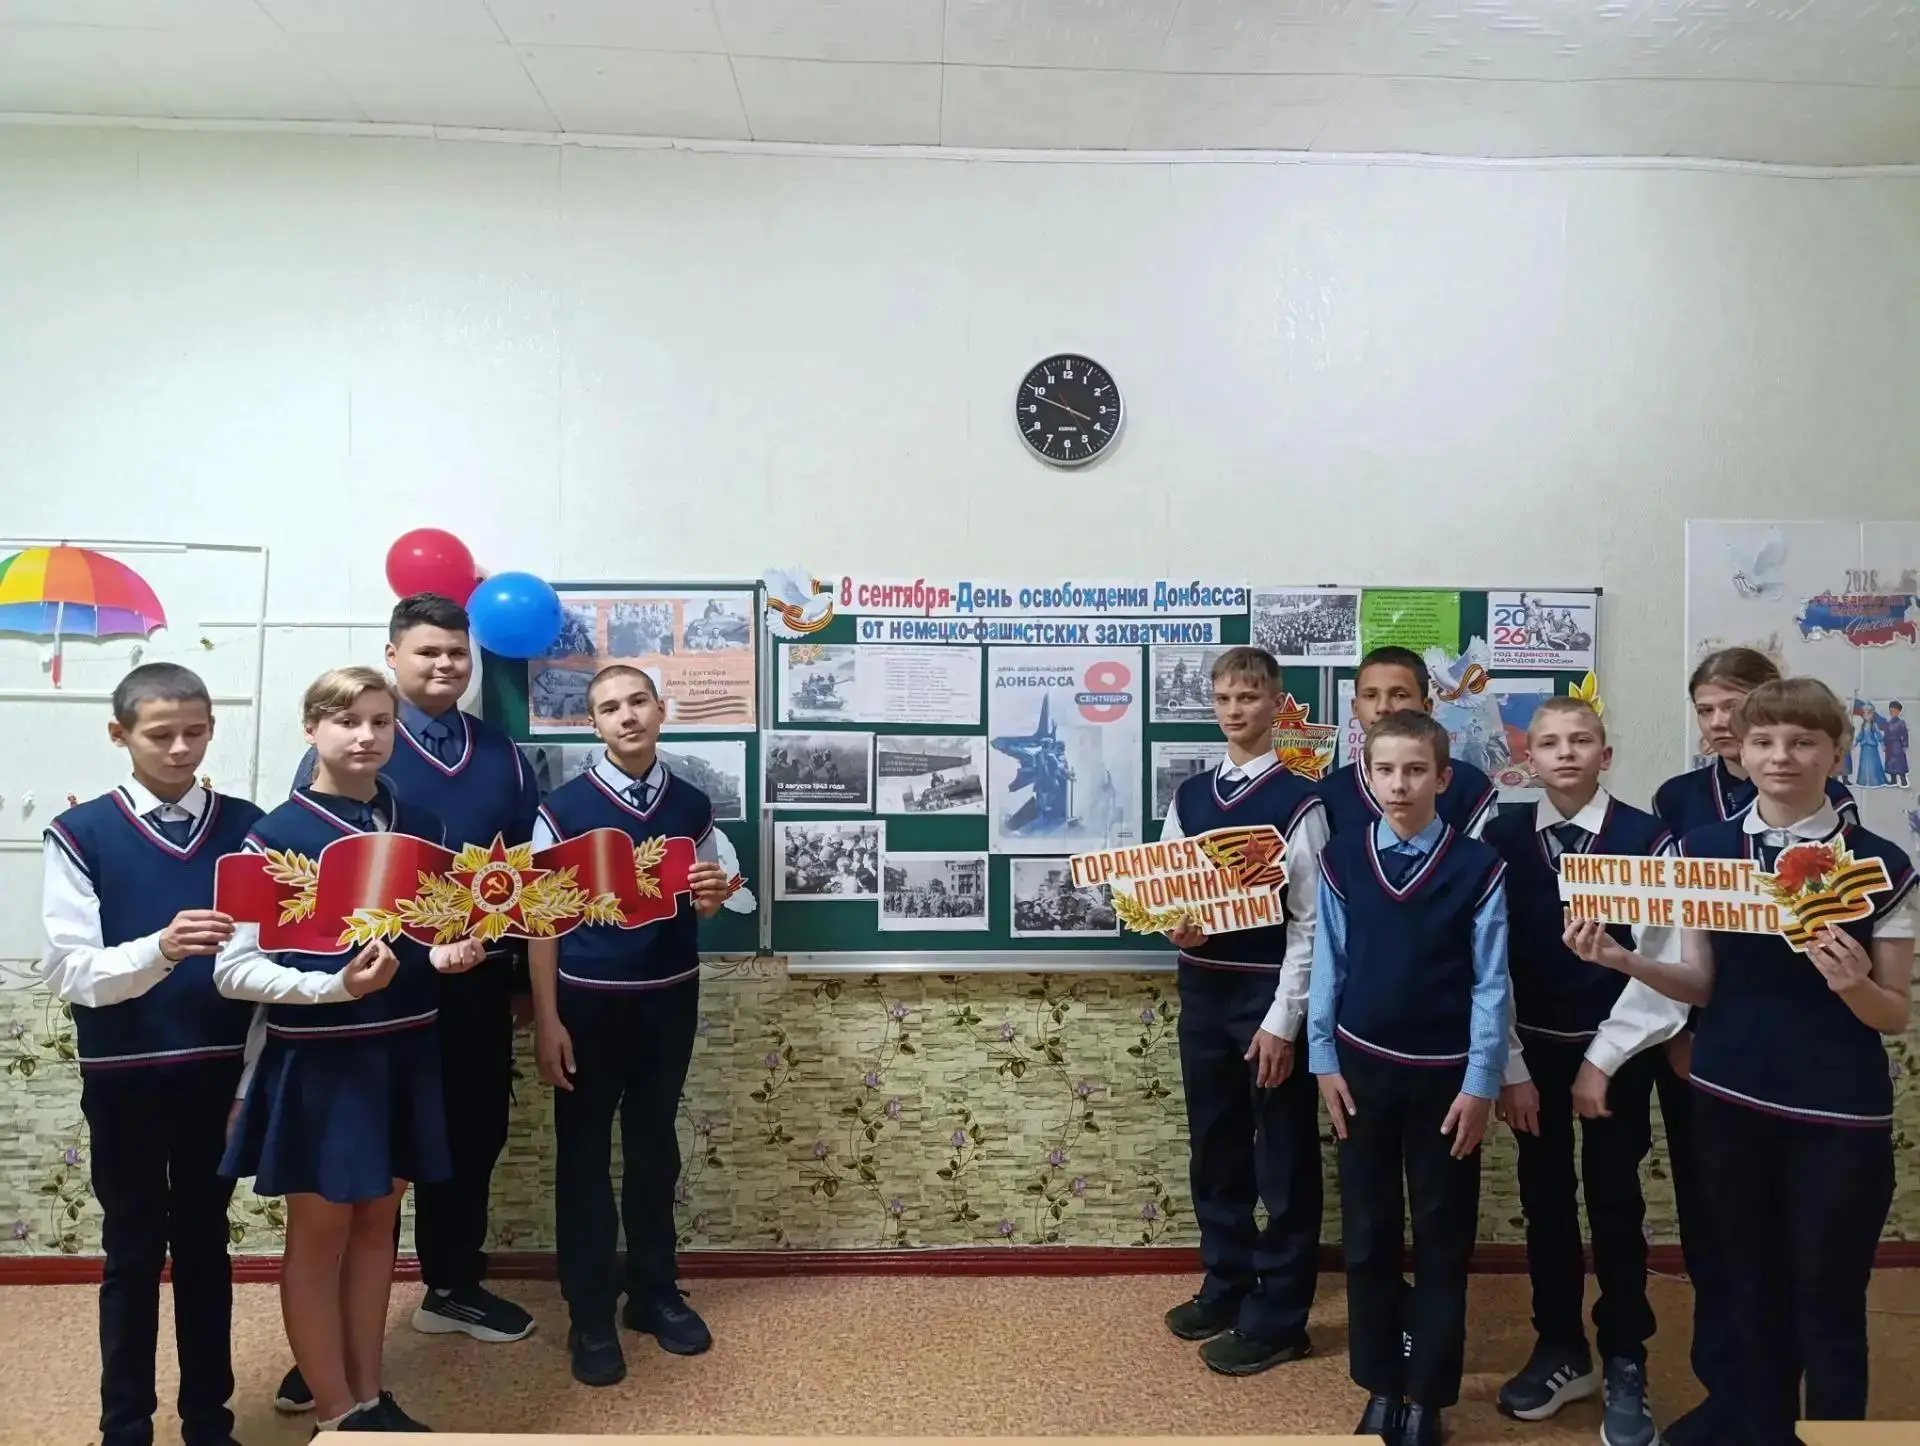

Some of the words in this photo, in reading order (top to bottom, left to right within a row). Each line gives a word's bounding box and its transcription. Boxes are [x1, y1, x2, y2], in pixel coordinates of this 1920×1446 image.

[1063, 371, 1073, 379] 12
[1047, 376, 1055, 384] 11
[1034, 387, 1045, 395] 10
[1094, 388, 1101, 396] 2
[1029, 405, 1037, 413] 9
[1099, 406, 1106, 414] 3
[1033, 422, 1041, 430] 8
[1093, 422, 1100, 431] 4
[1046, 434, 1054, 442] 7
[1081, 435, 1088, 443] 5
[1063, 439, 1071, 448] 6
[840, 576, 853, 607] 8
[1019, 580, 1148, 612] освобождения
[1153, 580, 1246, 612] Донбасса
[1494, 608, 1527, 627] 20
[862, 620, 884, 639] от
[890, 618, 1089, 643] немецко-фашистских
[1095, 622, 1213, 643] захватчиков
[1494, 627, 1527, 645] 26
[995, 676, 1075, 688] ДОНБАССА
[1078, 661, 1131, 723] 8
[1079, 694, 1128, 703] СЕНТЯБРЯ
[1071, 840, 1205, 887] ГОРДИМСЯ,
[1564, 857, 1632, 886] НИКТО
[1640, 859, 1666, 888] НЕ
[1673, 860, 1760, 896] ЗАБЫТ,
[1200, 893, 1281, 932] ЧТИМ!
[1572, 894, 1641, 924] НИЧТО
[1648, 897, 1675, 927] НЕ
[1681, 900, 1779, 933] ЗАБЫТО
